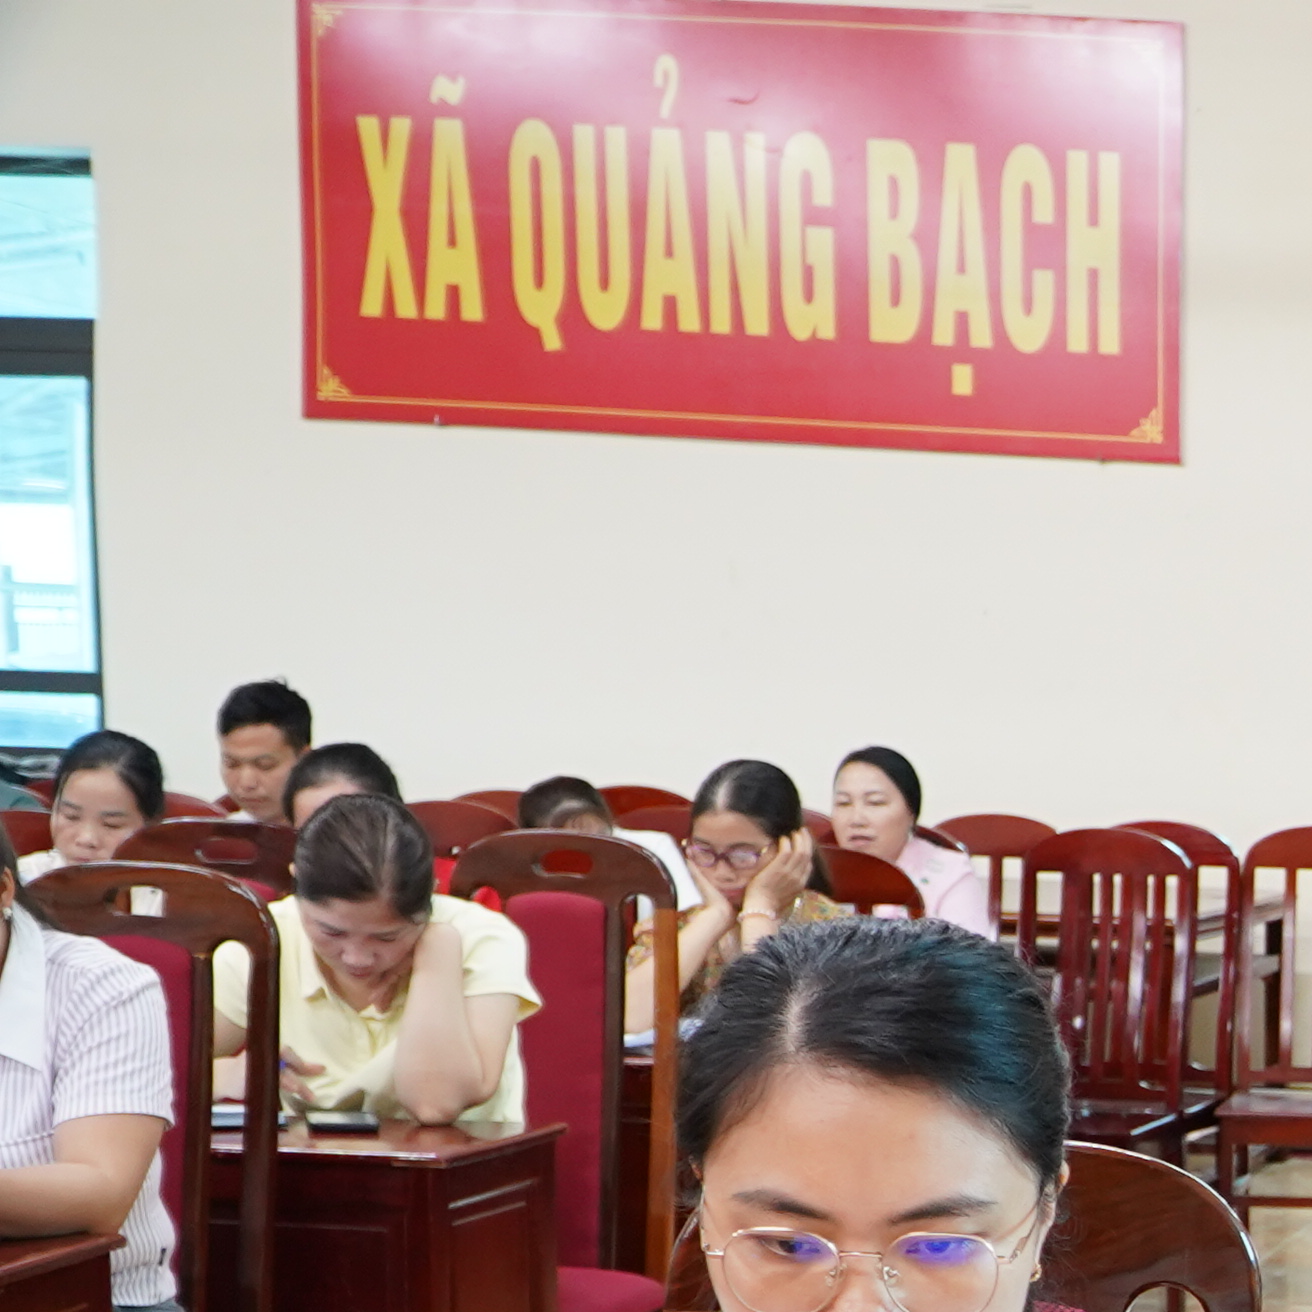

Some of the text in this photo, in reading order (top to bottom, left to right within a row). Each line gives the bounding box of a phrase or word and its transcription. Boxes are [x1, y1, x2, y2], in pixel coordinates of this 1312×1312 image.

[357, 54, 1121, 396] XÃ QUẢNG BẠCH
